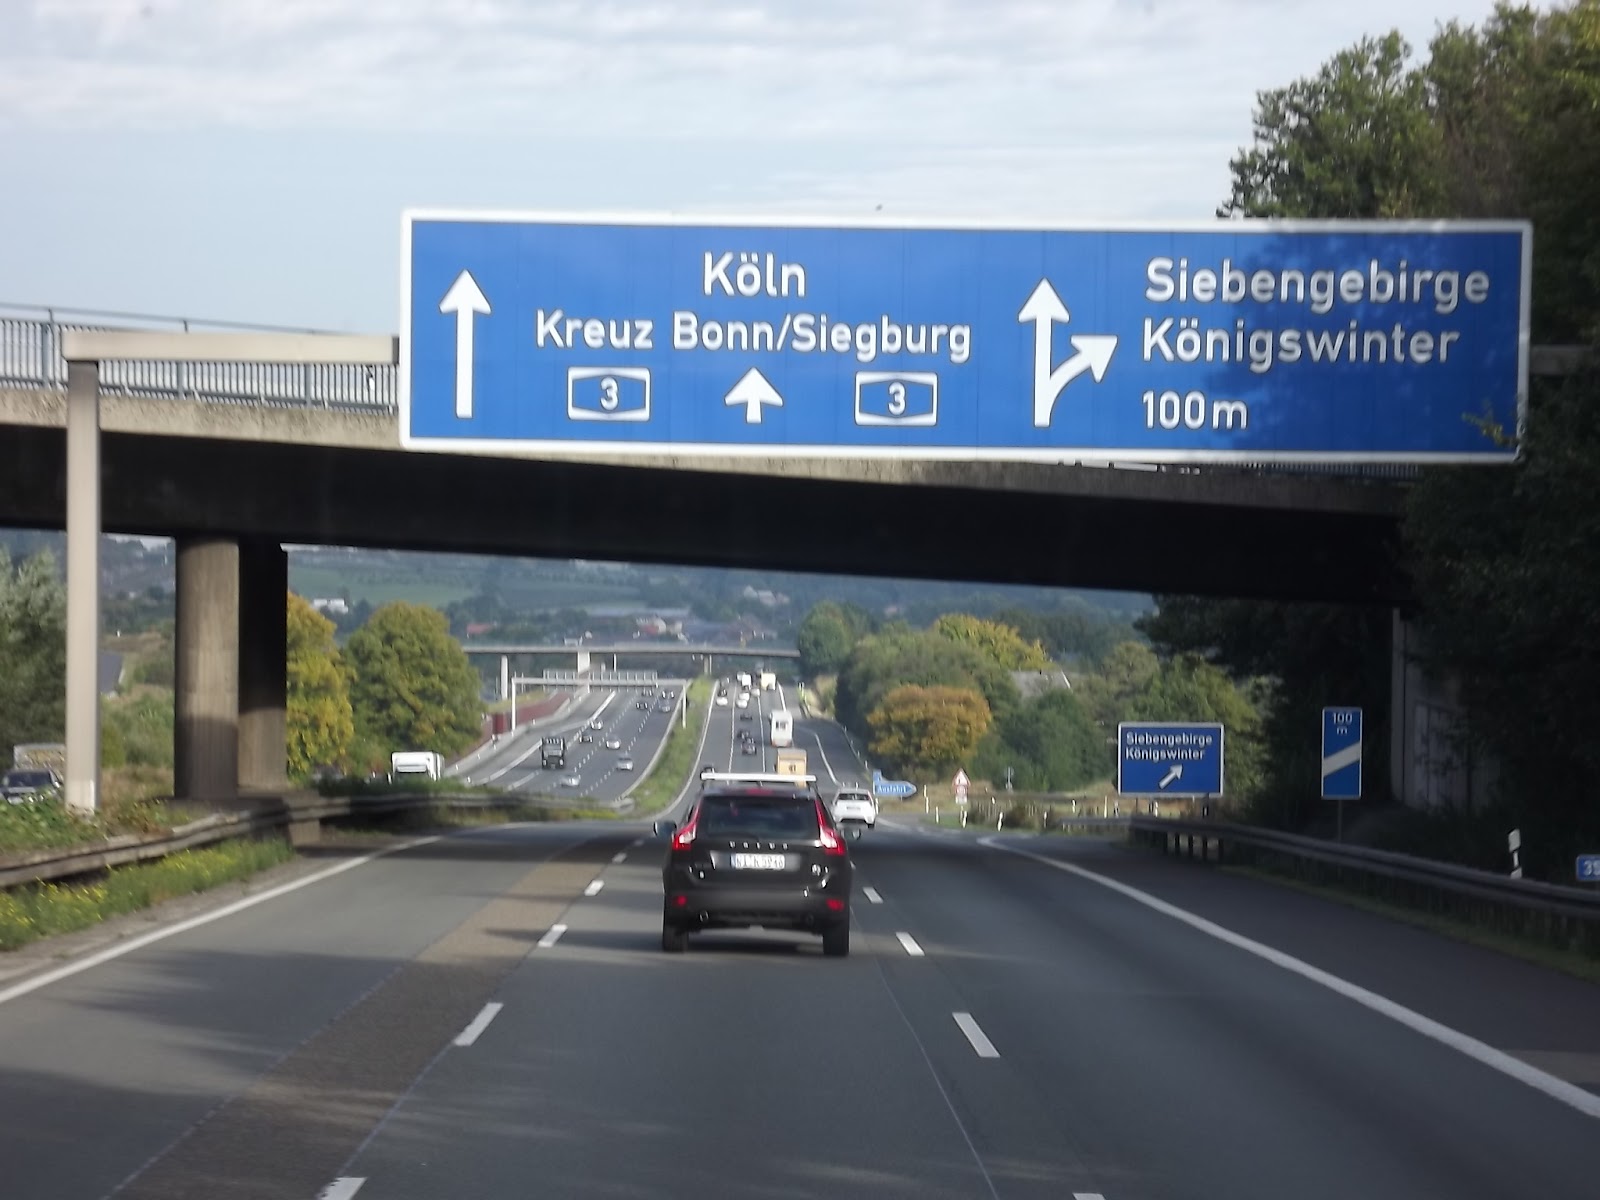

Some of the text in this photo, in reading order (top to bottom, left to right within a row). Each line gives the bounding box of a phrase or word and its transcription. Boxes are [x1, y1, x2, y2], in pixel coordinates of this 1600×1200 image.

[704, 251, 806, 297] Köln
[1145, 256, 1490, 313] Siebengebirge
[536, 309, 972, 363] Kreuz Bonn/Siegburg
[1143, 317, 1460, 373] Königswinter
[599, 377, 620, 410] 3
[887, 382, 907, 416] 3
[1333, 712, 1353, 726] 100
[1125, 747, 1206, 763] Königswinter
[1126, 731, 1213, 748] Siebengebirge
